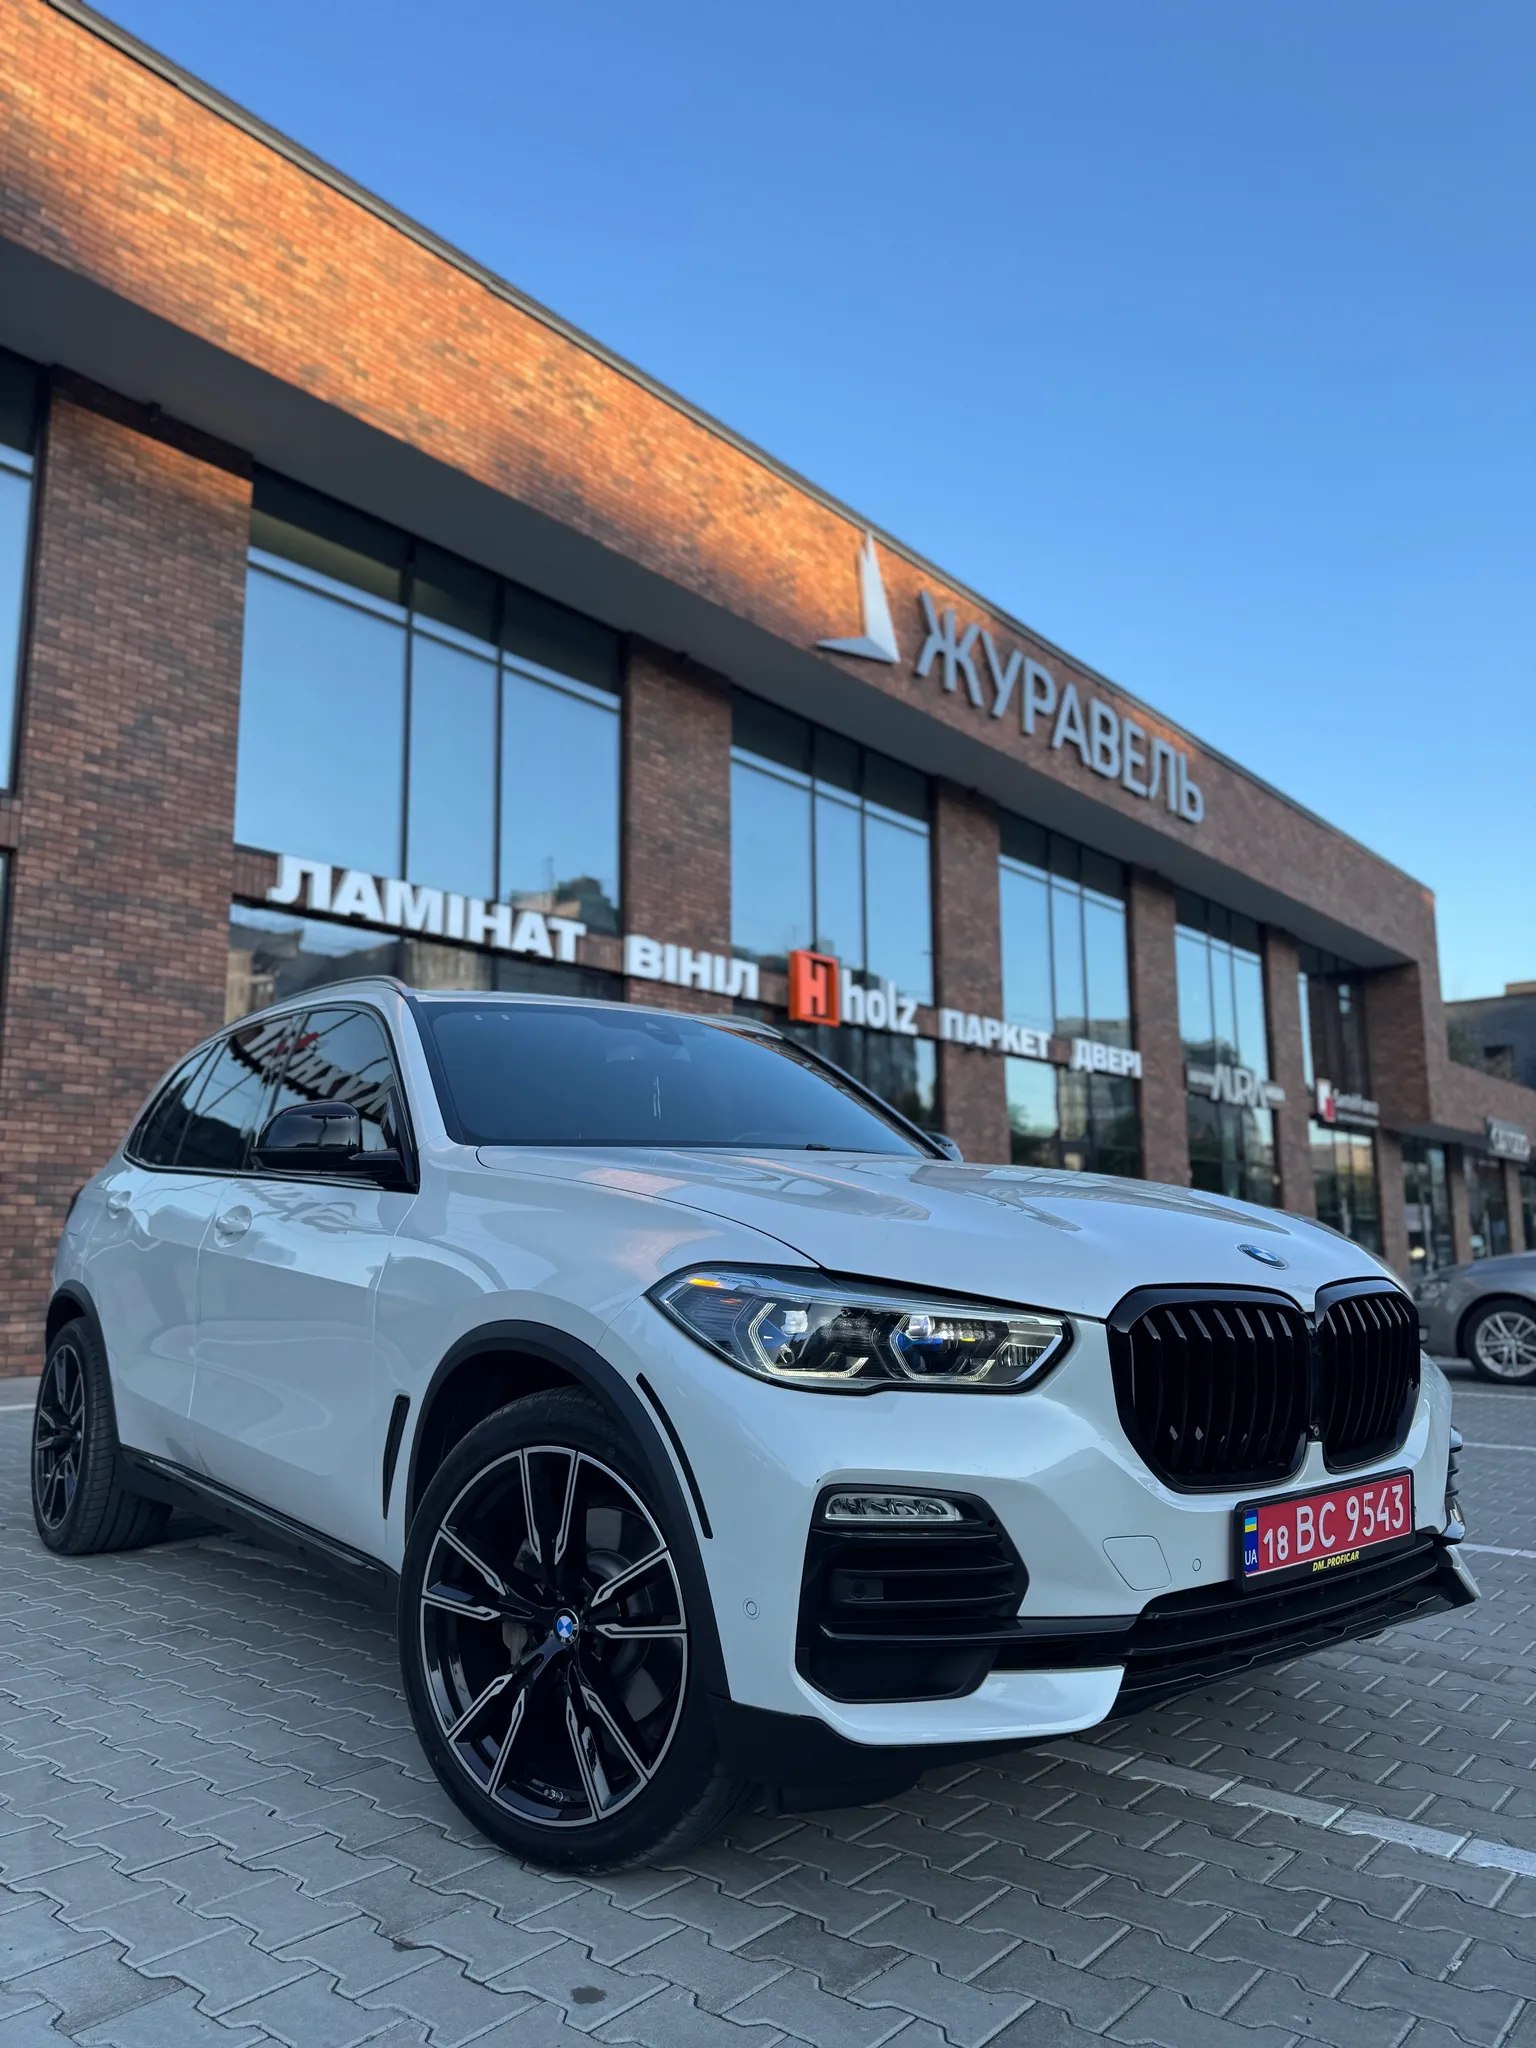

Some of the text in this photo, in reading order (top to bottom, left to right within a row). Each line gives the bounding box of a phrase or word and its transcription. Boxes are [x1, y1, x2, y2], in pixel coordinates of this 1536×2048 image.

[914, 590, 1205, 825] ЖУРАВЕЛЬ
[266, 854, 759, 1000] ЛАМІНАТ ВІНІЛ
[840, 968, 919, 1036] holz
[939, 1008, 1142, 1079] ПАРКЕТ ДВЕРІ
[1244, 1549, 1258, 1566] UA
[1262, 1484, 1404, 1564] 18 BC 9543
